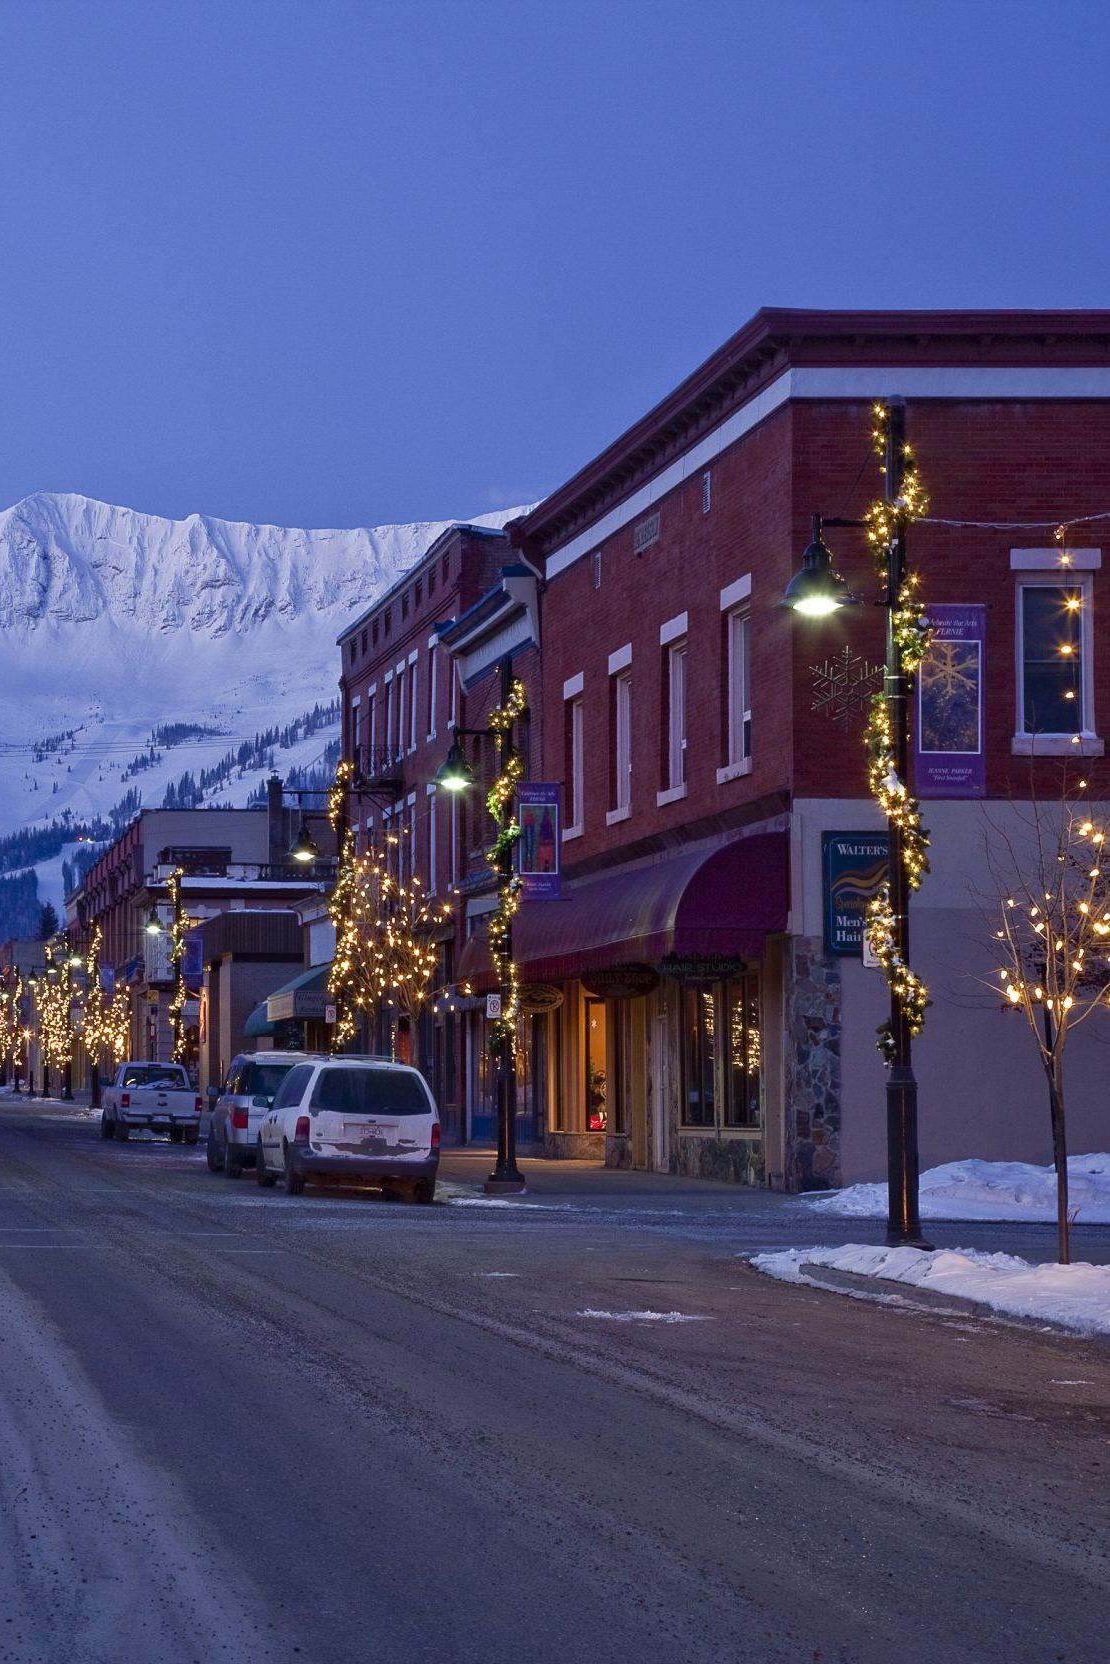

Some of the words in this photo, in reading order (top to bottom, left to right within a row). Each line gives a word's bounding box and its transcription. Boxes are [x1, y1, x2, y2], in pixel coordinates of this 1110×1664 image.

[952, 619, 964, 627] the
[965, 619, 978, 627] Arts
[936, 627, 964, 636] FERNIE
[837, 843, 889, 856] WALTER'S
[836, 915, 867, 927] Men's
[836, 930, 862, 942] Hair
